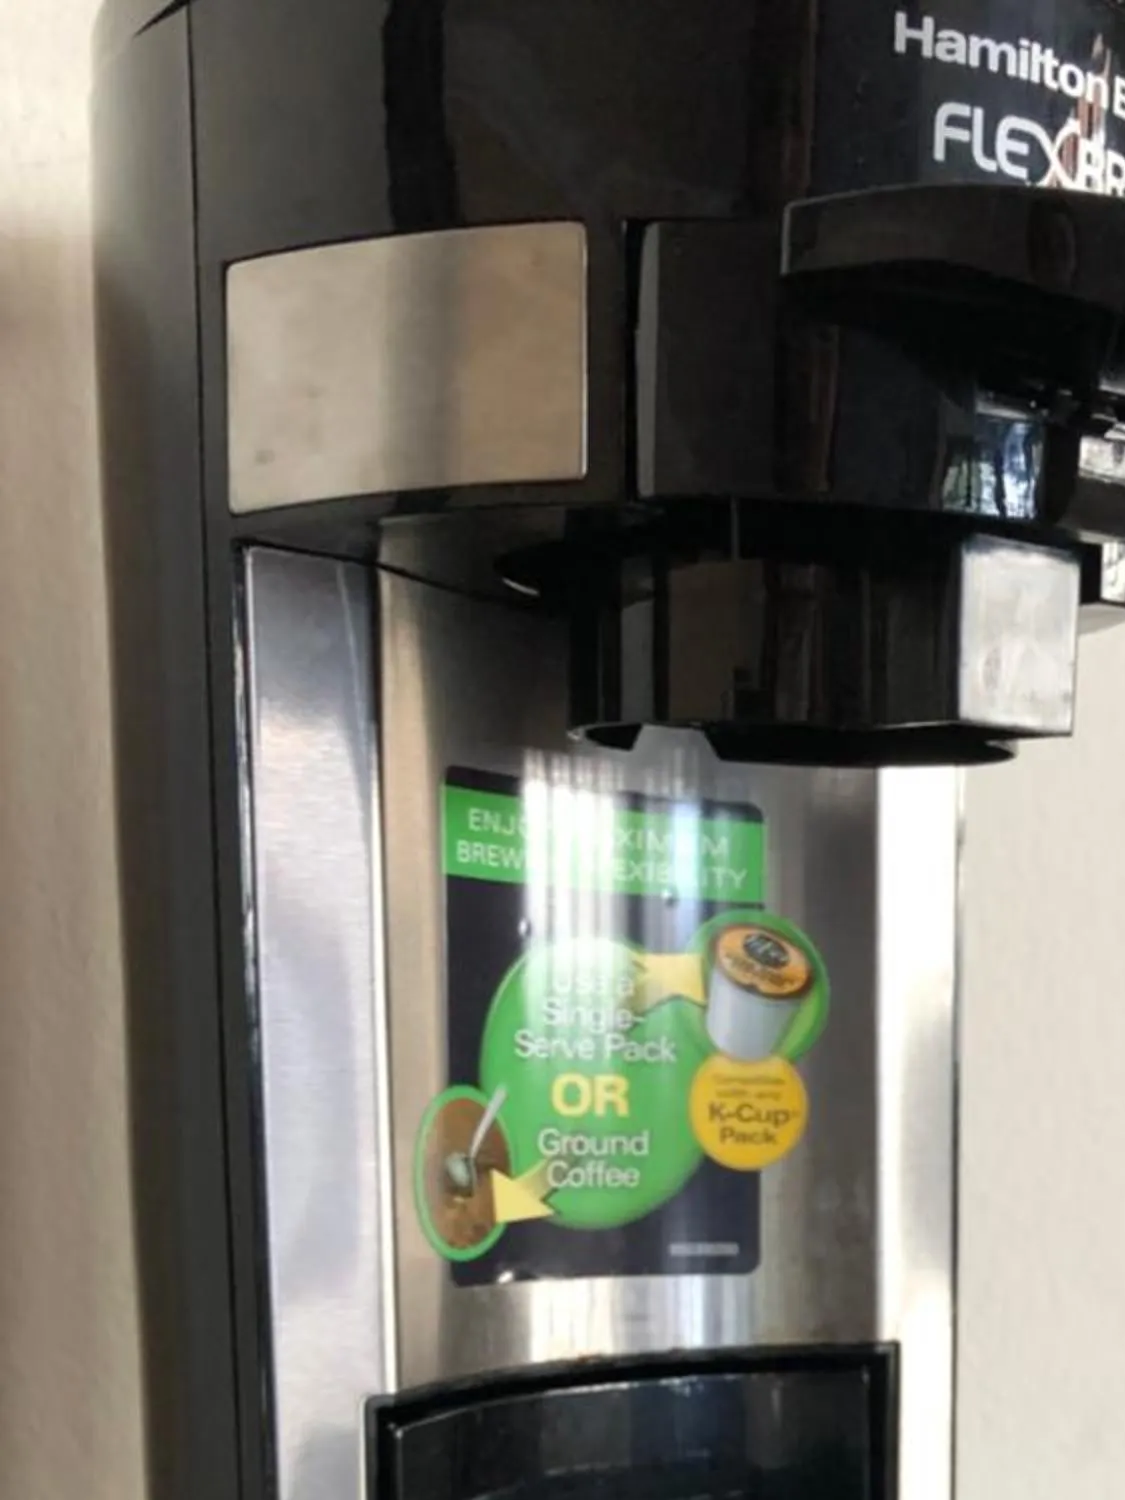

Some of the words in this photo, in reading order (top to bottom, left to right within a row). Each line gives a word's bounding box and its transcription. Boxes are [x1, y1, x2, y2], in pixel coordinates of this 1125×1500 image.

[894, 11, 1109, 109] Hamilton
[467, 807, 533, 840] ENJ
[514, 1029, 596, 1061] Serve
[604, 1033, 678, 1063] Pack
[551, 1073, 631, 1118] OR
[538, 1127, 650, 1156] Ground
[719, 1126, 778, 1146] Pack
[547, 1160, 641, 1188] Coffee
